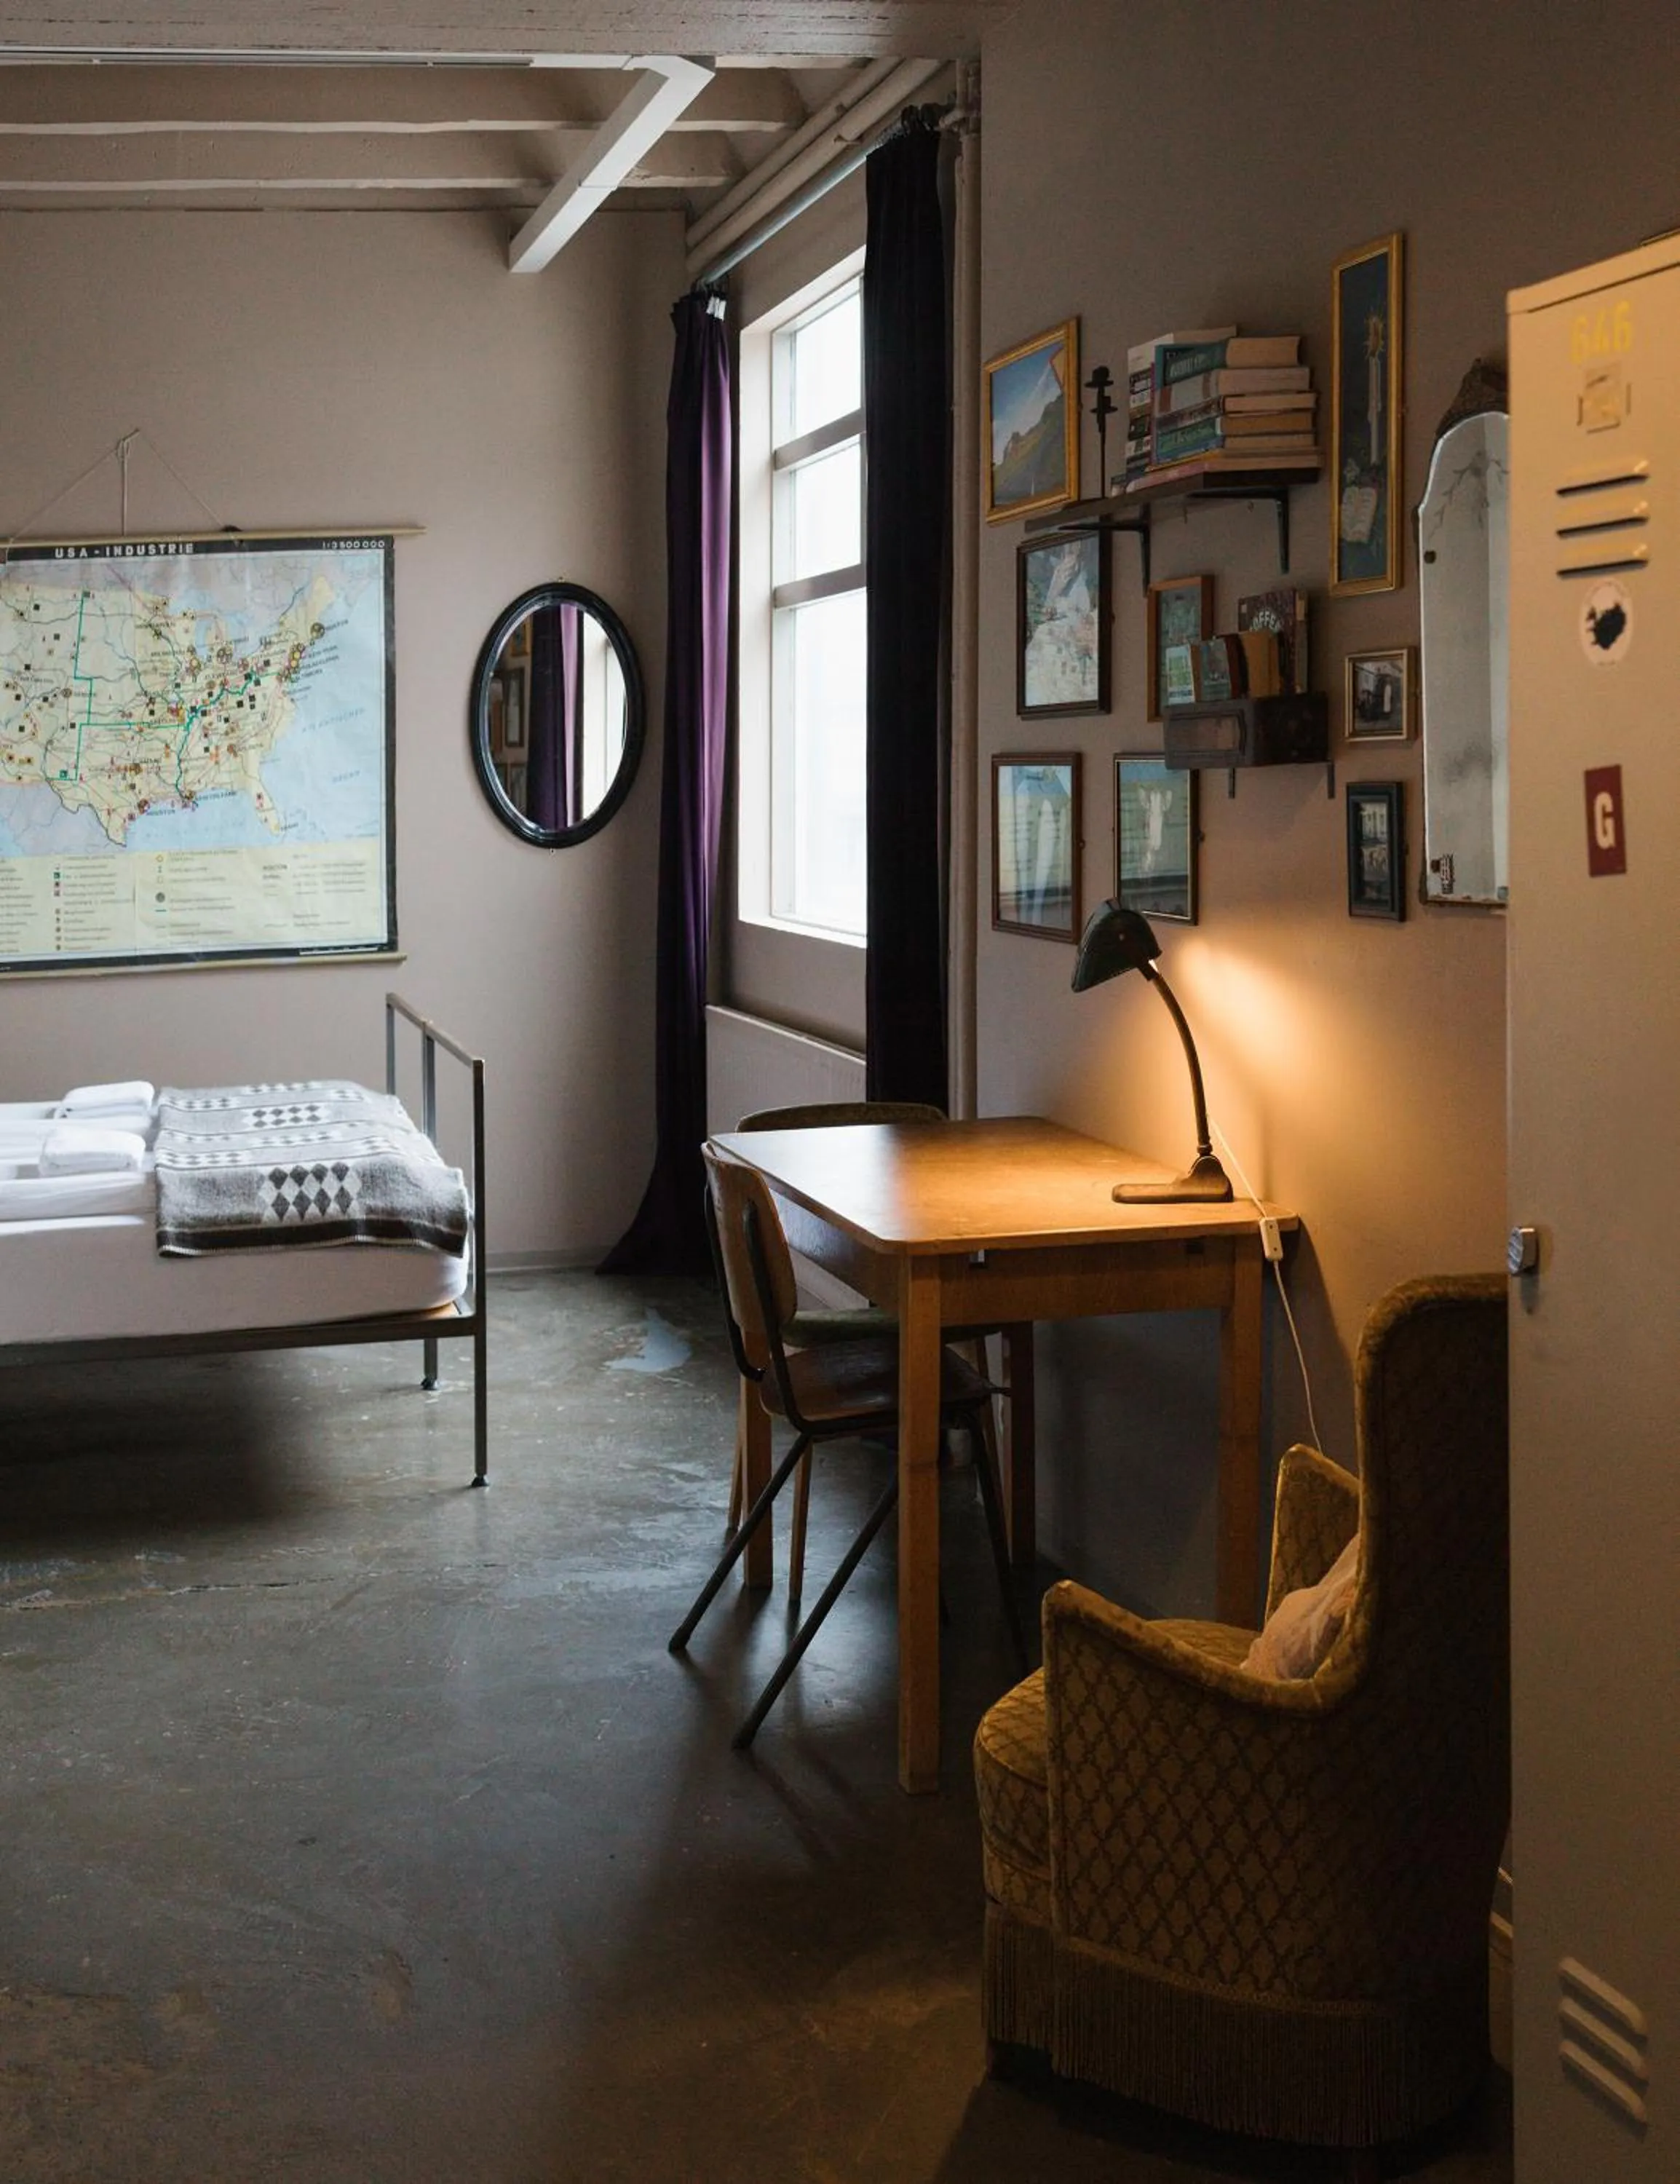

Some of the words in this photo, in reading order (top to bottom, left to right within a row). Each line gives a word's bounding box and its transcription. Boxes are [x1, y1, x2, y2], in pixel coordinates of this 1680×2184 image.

[55, 547, 88, 558] USA
[106, 543, 194, 557] INDUSTRIE
[1593, 791, 1616, 850] G
